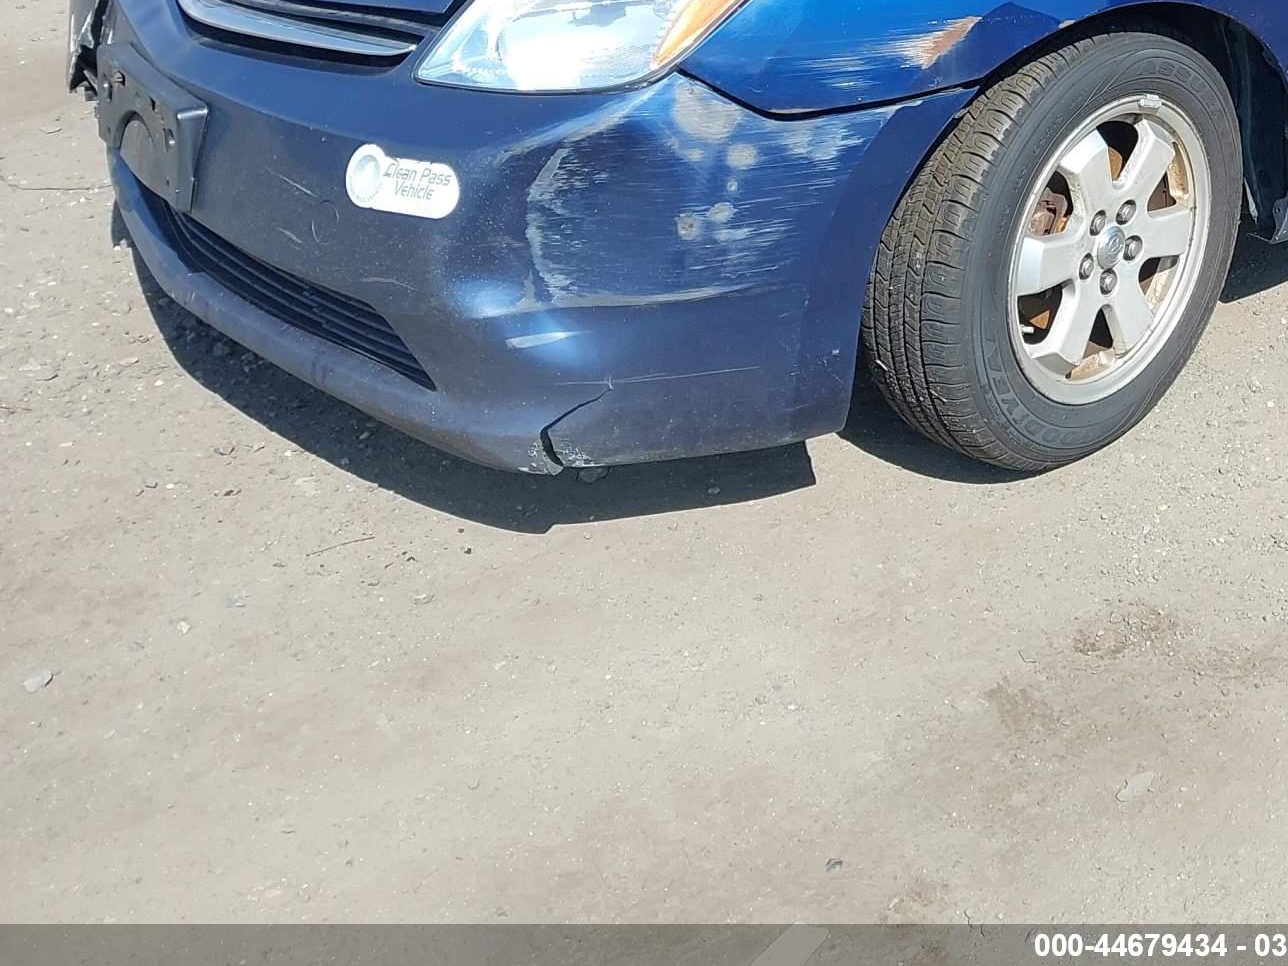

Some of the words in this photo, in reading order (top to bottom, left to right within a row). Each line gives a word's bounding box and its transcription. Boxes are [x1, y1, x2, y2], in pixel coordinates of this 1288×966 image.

[383, 161, 417, 182] Clean
[419, 167, 452, 187] Pass
[394, 181, 434, 200] Vehicle
